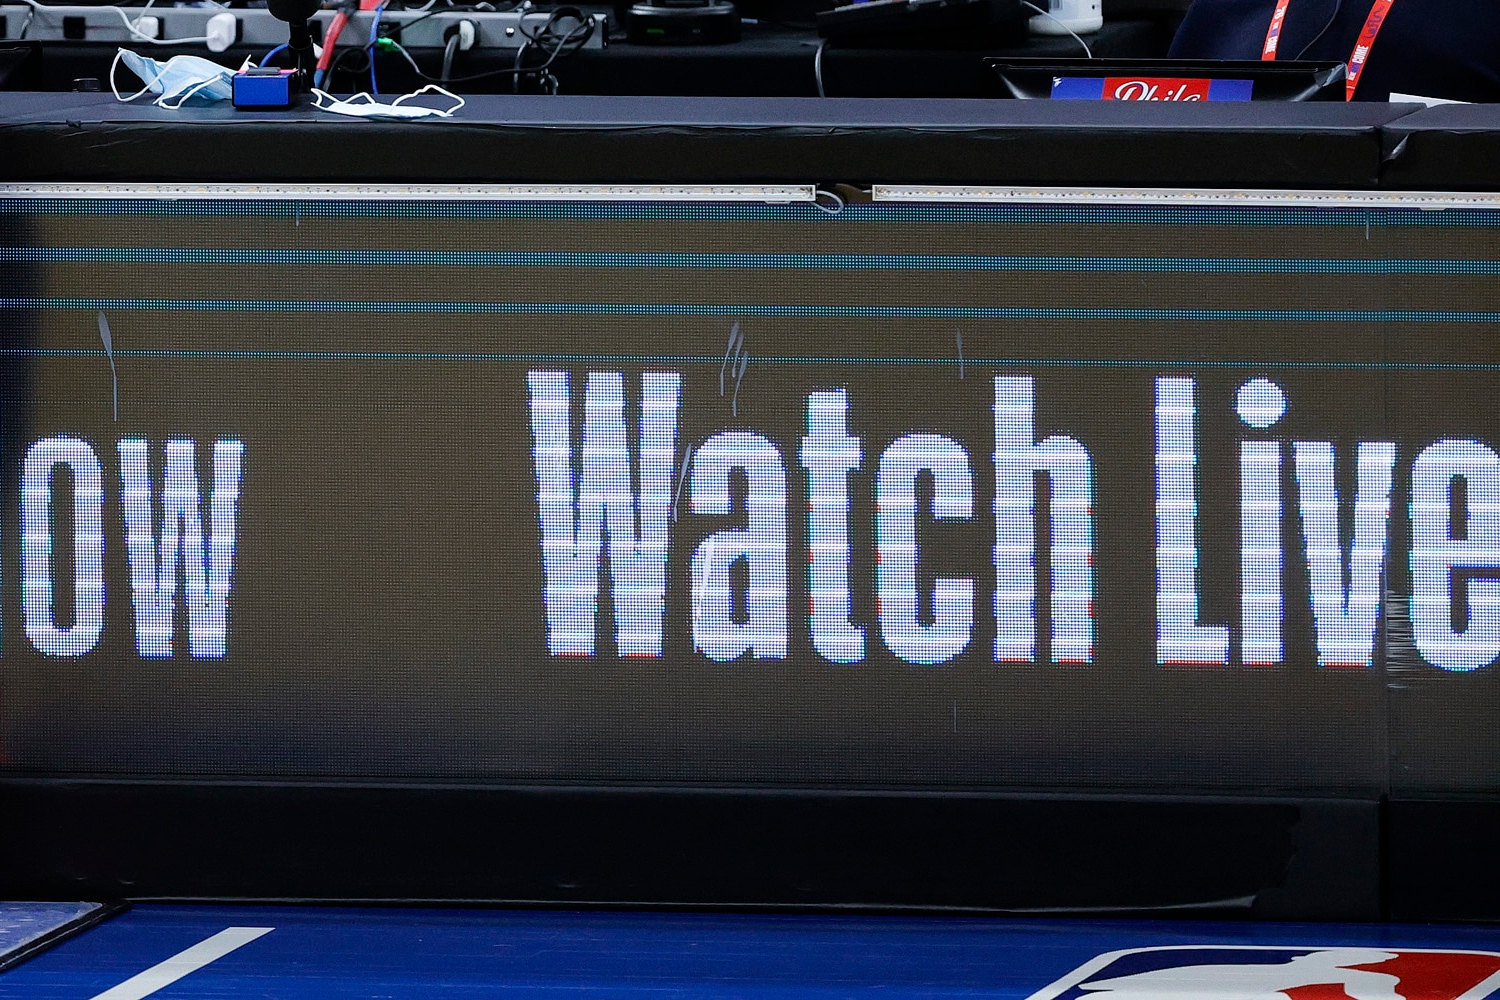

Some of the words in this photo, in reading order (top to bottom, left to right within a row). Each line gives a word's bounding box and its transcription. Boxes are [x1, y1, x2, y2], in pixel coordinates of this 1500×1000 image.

[1352, 45, 1368, 64] COME
[526, 369, 1096, 664] Watch
[1153, 376, 1500, 672] Live
